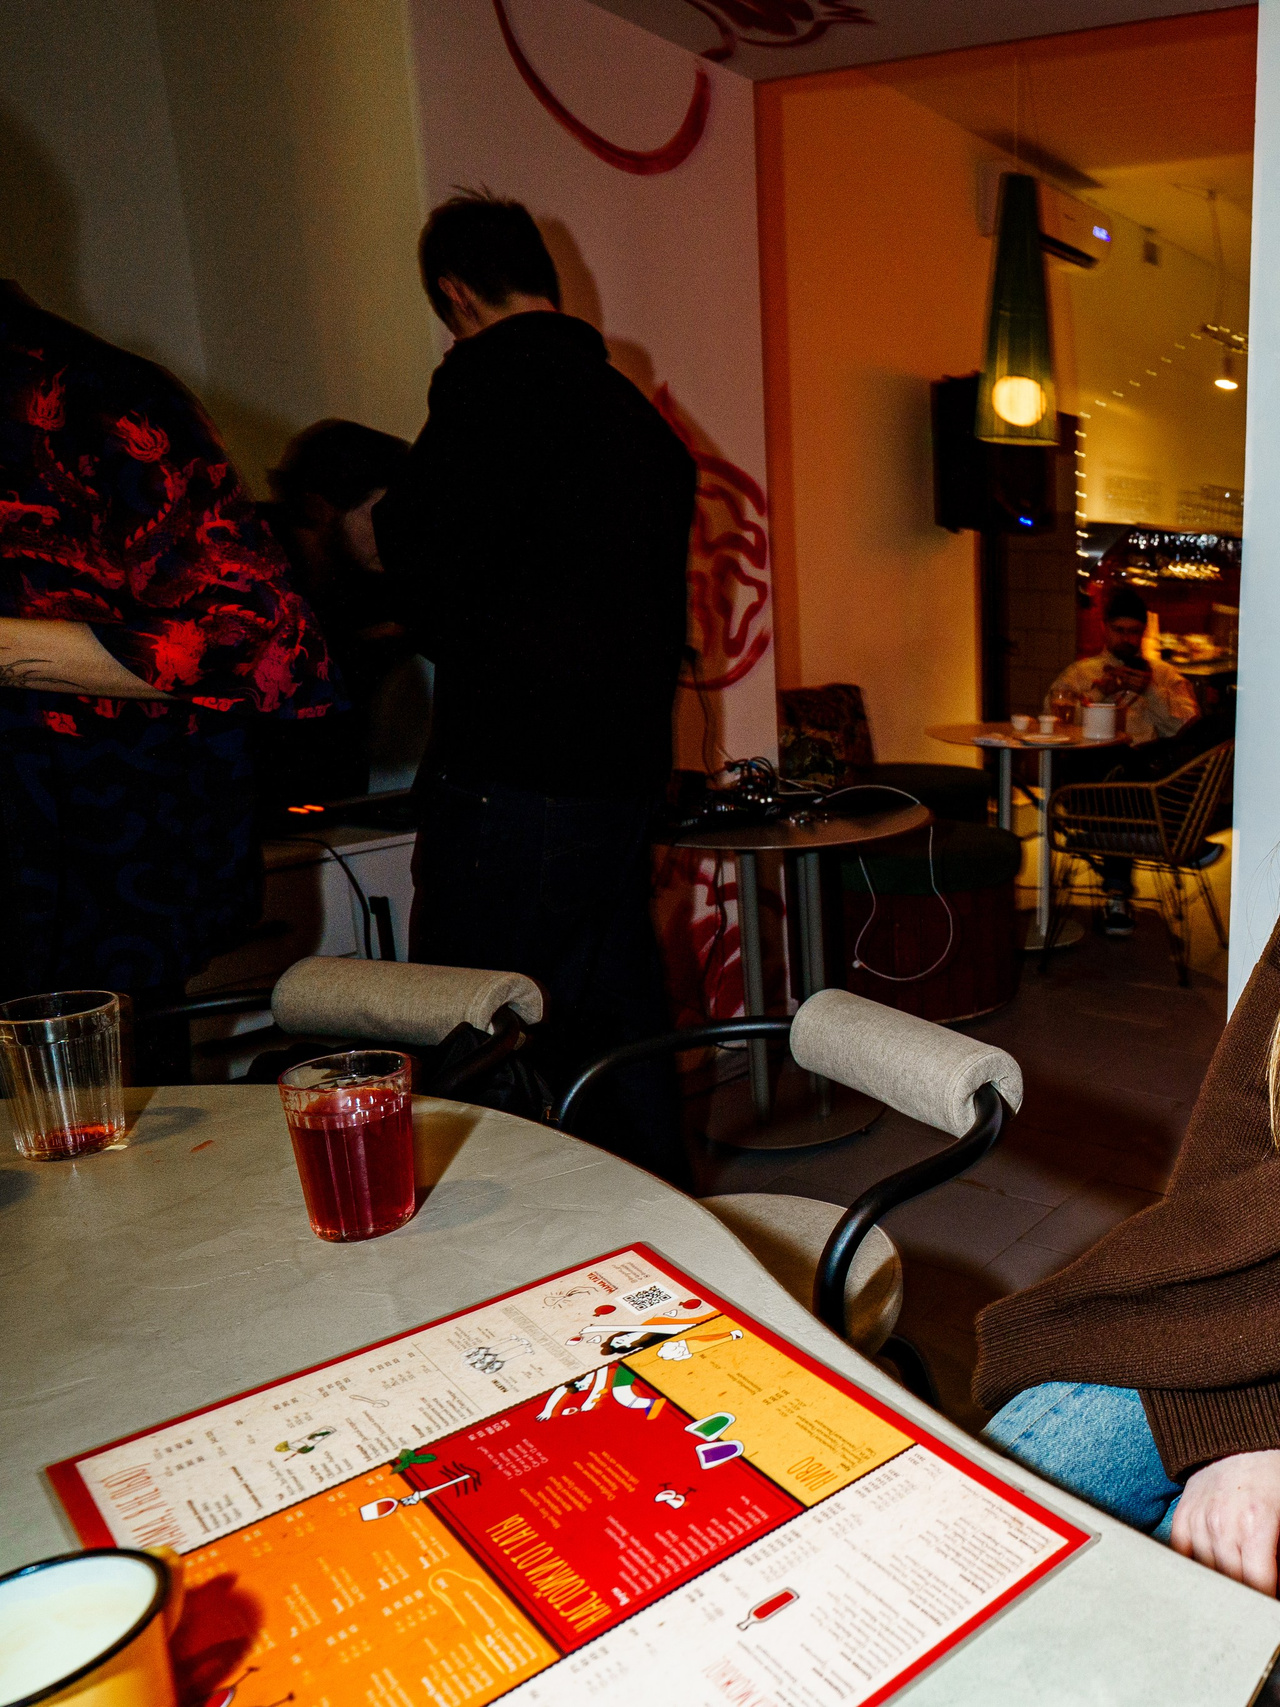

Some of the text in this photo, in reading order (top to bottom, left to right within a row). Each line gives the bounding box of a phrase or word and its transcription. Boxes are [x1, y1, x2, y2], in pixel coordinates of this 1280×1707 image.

[486, 1514, 538, 1554] ТАТЫ
[511, 1542, 553, 1569] ОТ
[525, 1556, 611, 1632] НАСТОЙКИ
